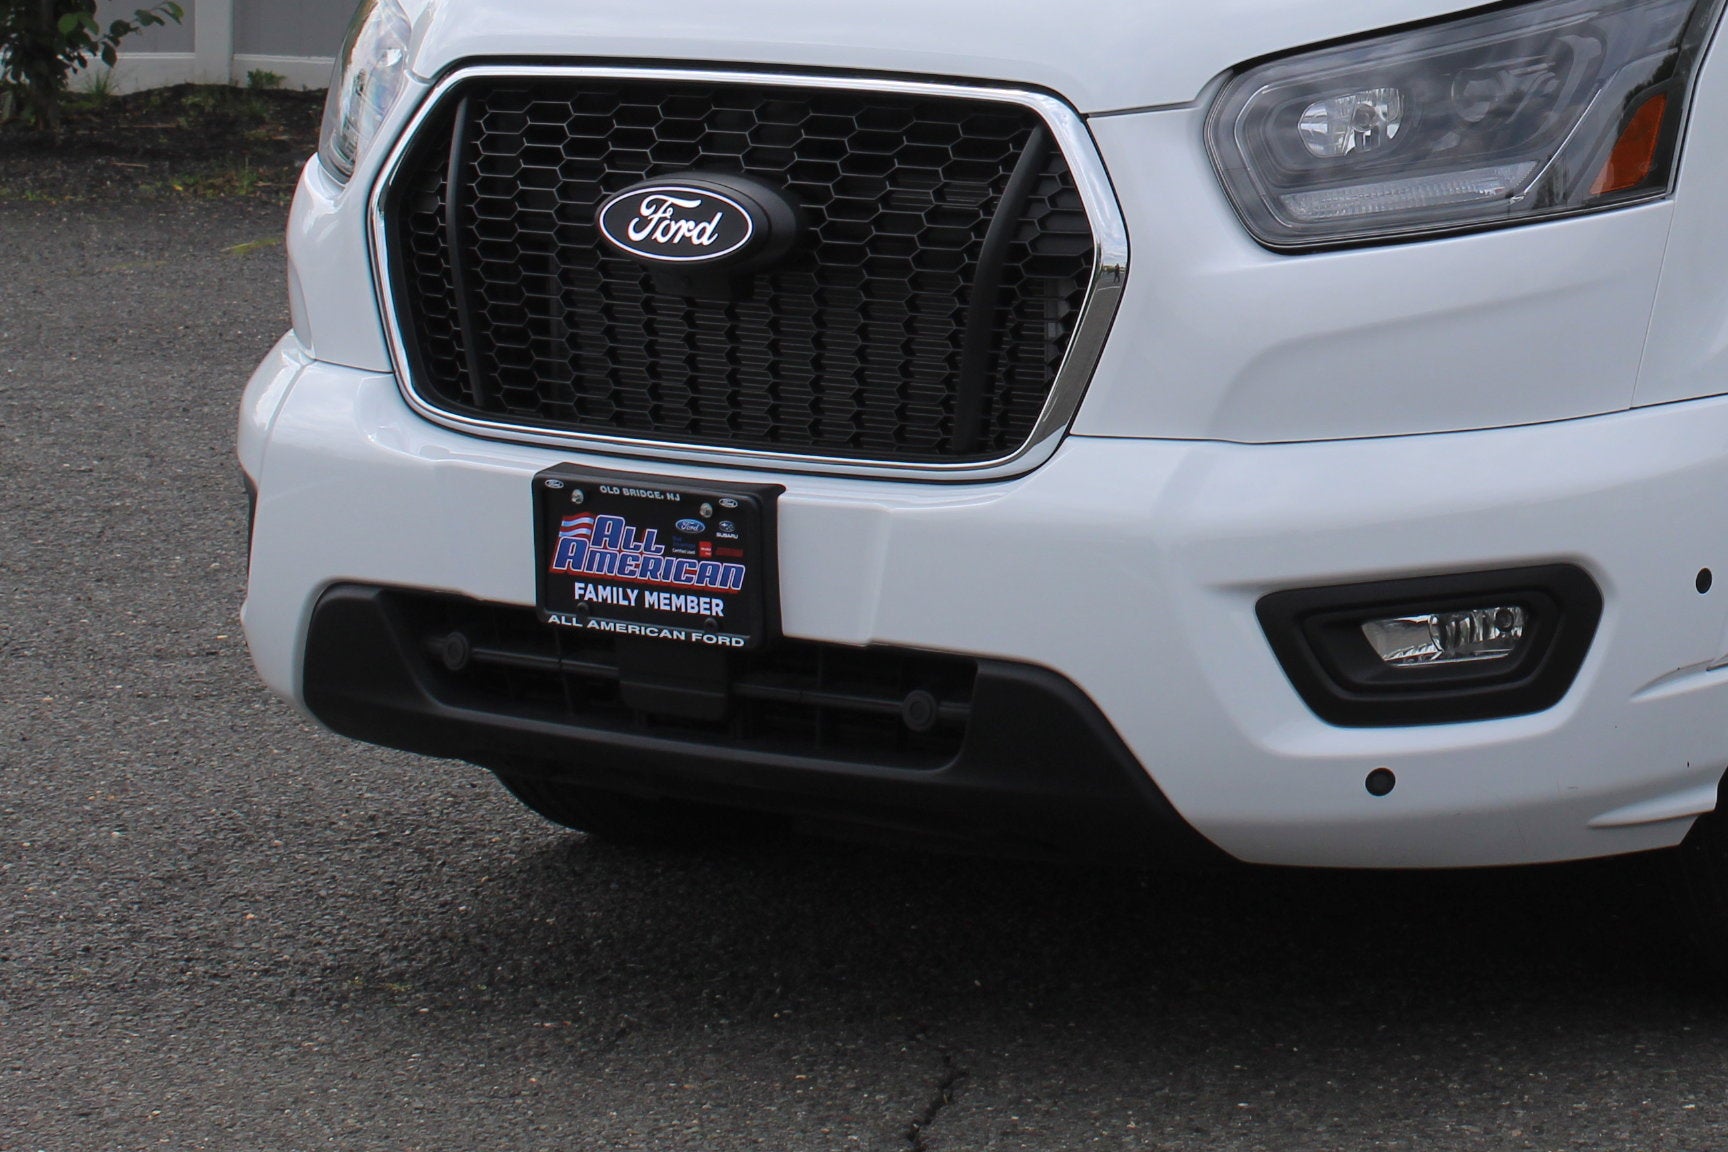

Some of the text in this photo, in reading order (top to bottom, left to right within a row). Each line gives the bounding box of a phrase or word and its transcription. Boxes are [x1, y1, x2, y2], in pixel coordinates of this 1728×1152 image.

[628, 195, 723, 246] Ford
[600, 485, 620, 494] OLD
[667, 493, 680, 501] NJ
[574, 582, 724, 617] FAMILY MEMBER
[548, 614, 745, 648] ALL AMERICAN FORD
